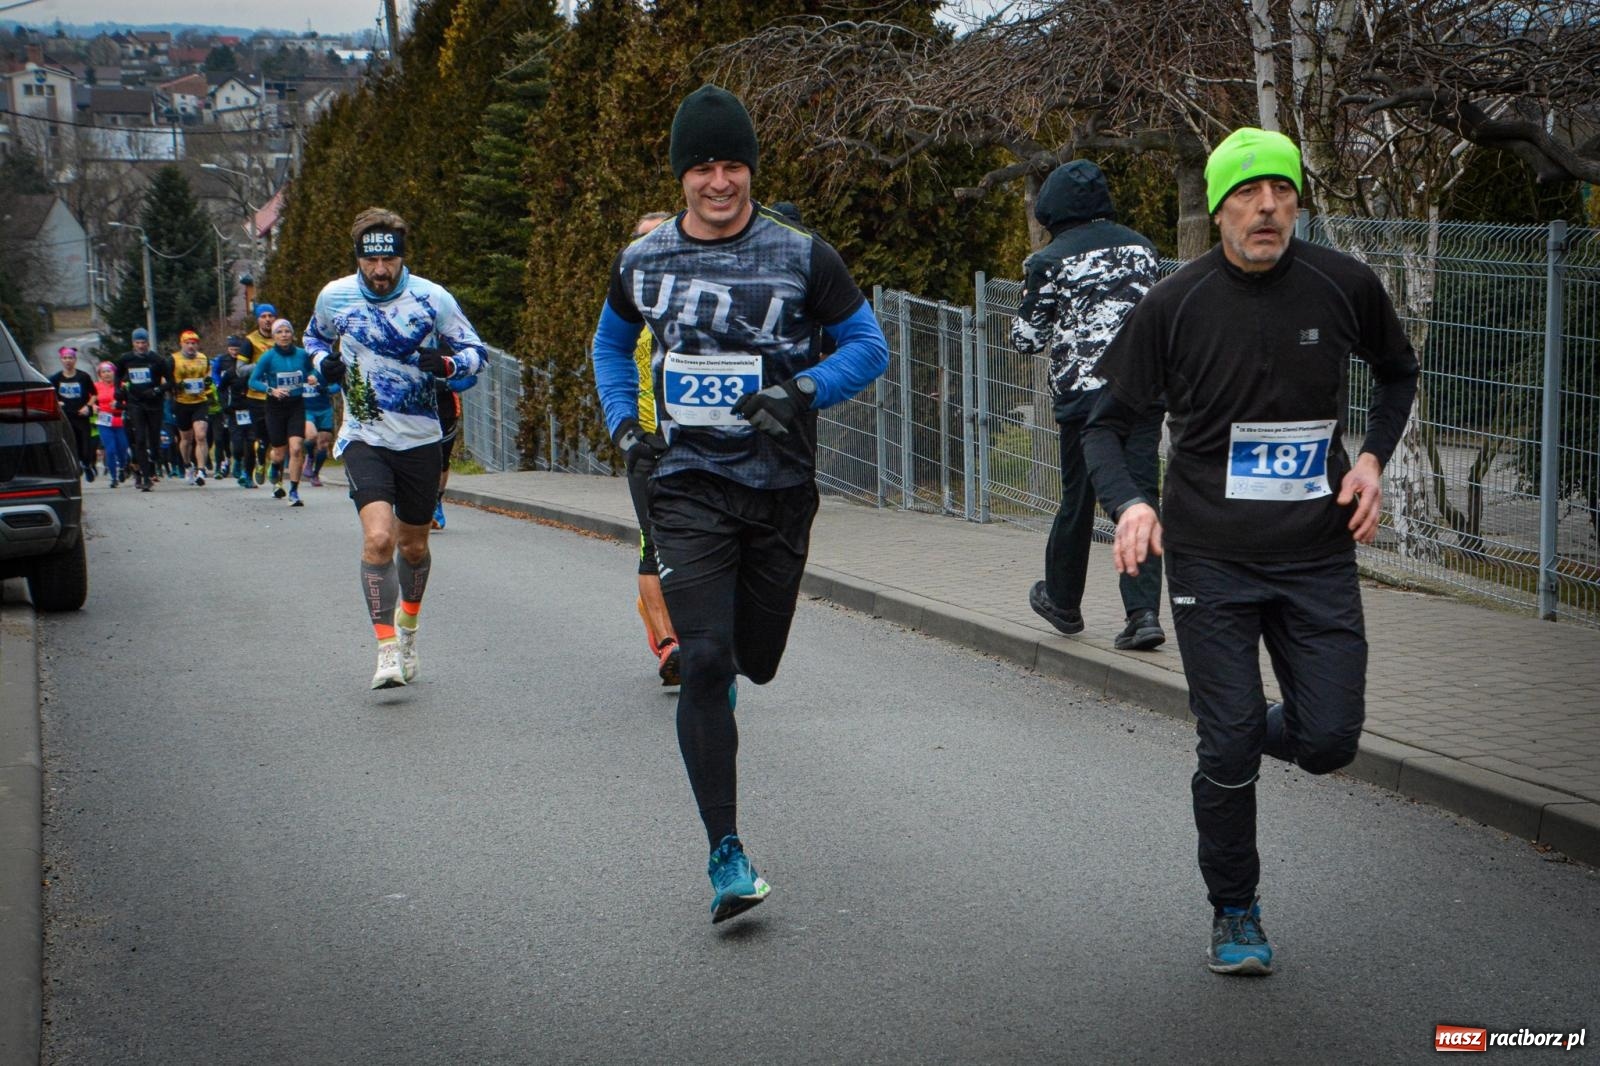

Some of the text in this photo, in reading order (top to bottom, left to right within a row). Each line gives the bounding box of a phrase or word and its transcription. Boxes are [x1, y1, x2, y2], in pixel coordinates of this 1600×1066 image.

[362, 232, 394, 244] BIEG
[363, 243, 394, 253] ZBÓJA
[680, 375, 745, 405] 233
[1251, 442, 1318, 476] 187
